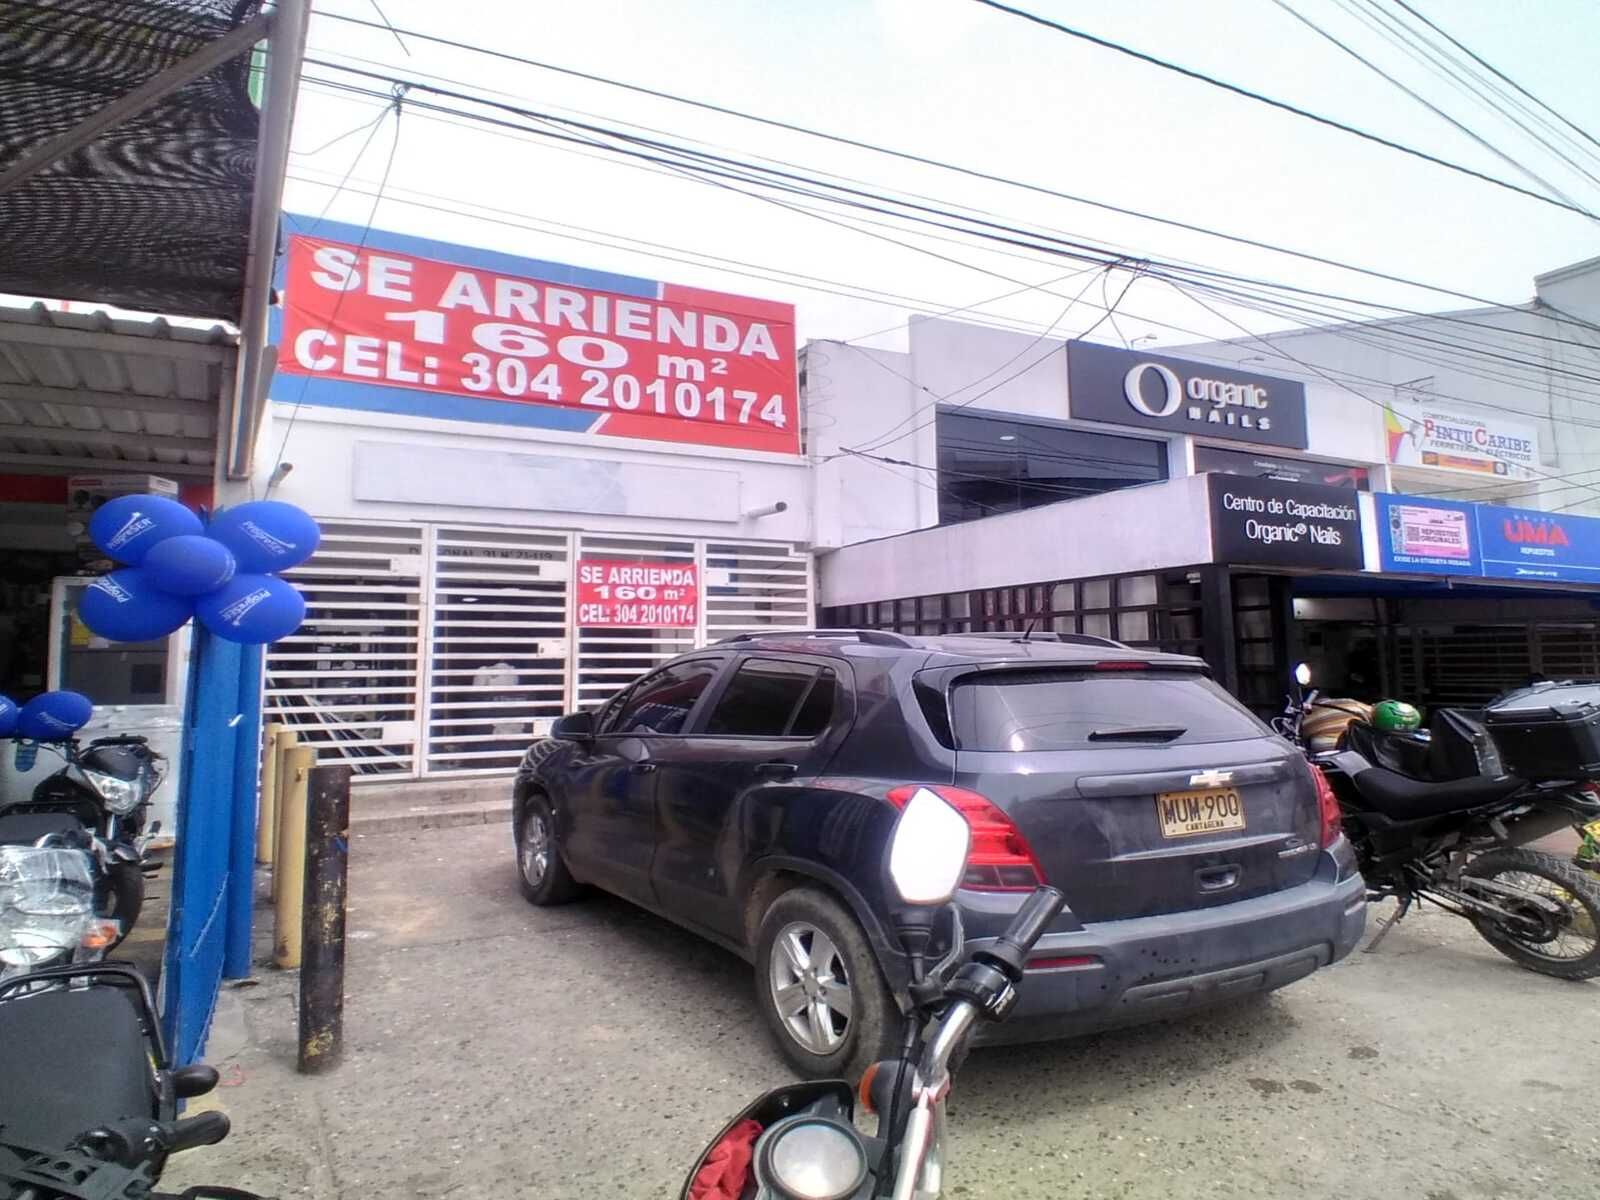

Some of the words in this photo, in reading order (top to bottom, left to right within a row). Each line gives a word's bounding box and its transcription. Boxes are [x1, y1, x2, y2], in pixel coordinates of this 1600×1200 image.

[310, 247, 413, 302] SE
[437, 271, 779, 360] ARRIENDA
[385, 310, 628, 369] 160
[294, 329, 438, 385] CEL:
[460, 352, 562, 401] 304
[581, 370, 786, 428] 2010174
[1187, 377, 1267, 409] organic
[1187, 406, 1271, 430] NAILS
[1223, 493, 1264, 512] Centro
[1267, 498, 1283, 514] de
[1286, 499, 1357, 521] Capacitación
[1309, 525, 1342, 545] Nails
[1504, 519, 1569, 546] UMA
[580, 566, 603, 583] SE
[608, 567, 695, 586] ARRIENDA
[593, 585, 657, 600] 160
[579, 604, 610, 622] CEL:
[614, 604, 637, 622] 304
[641, 605, 695, 623] 2010174
[1185, 820, 1224, 832] CARTAGENA
